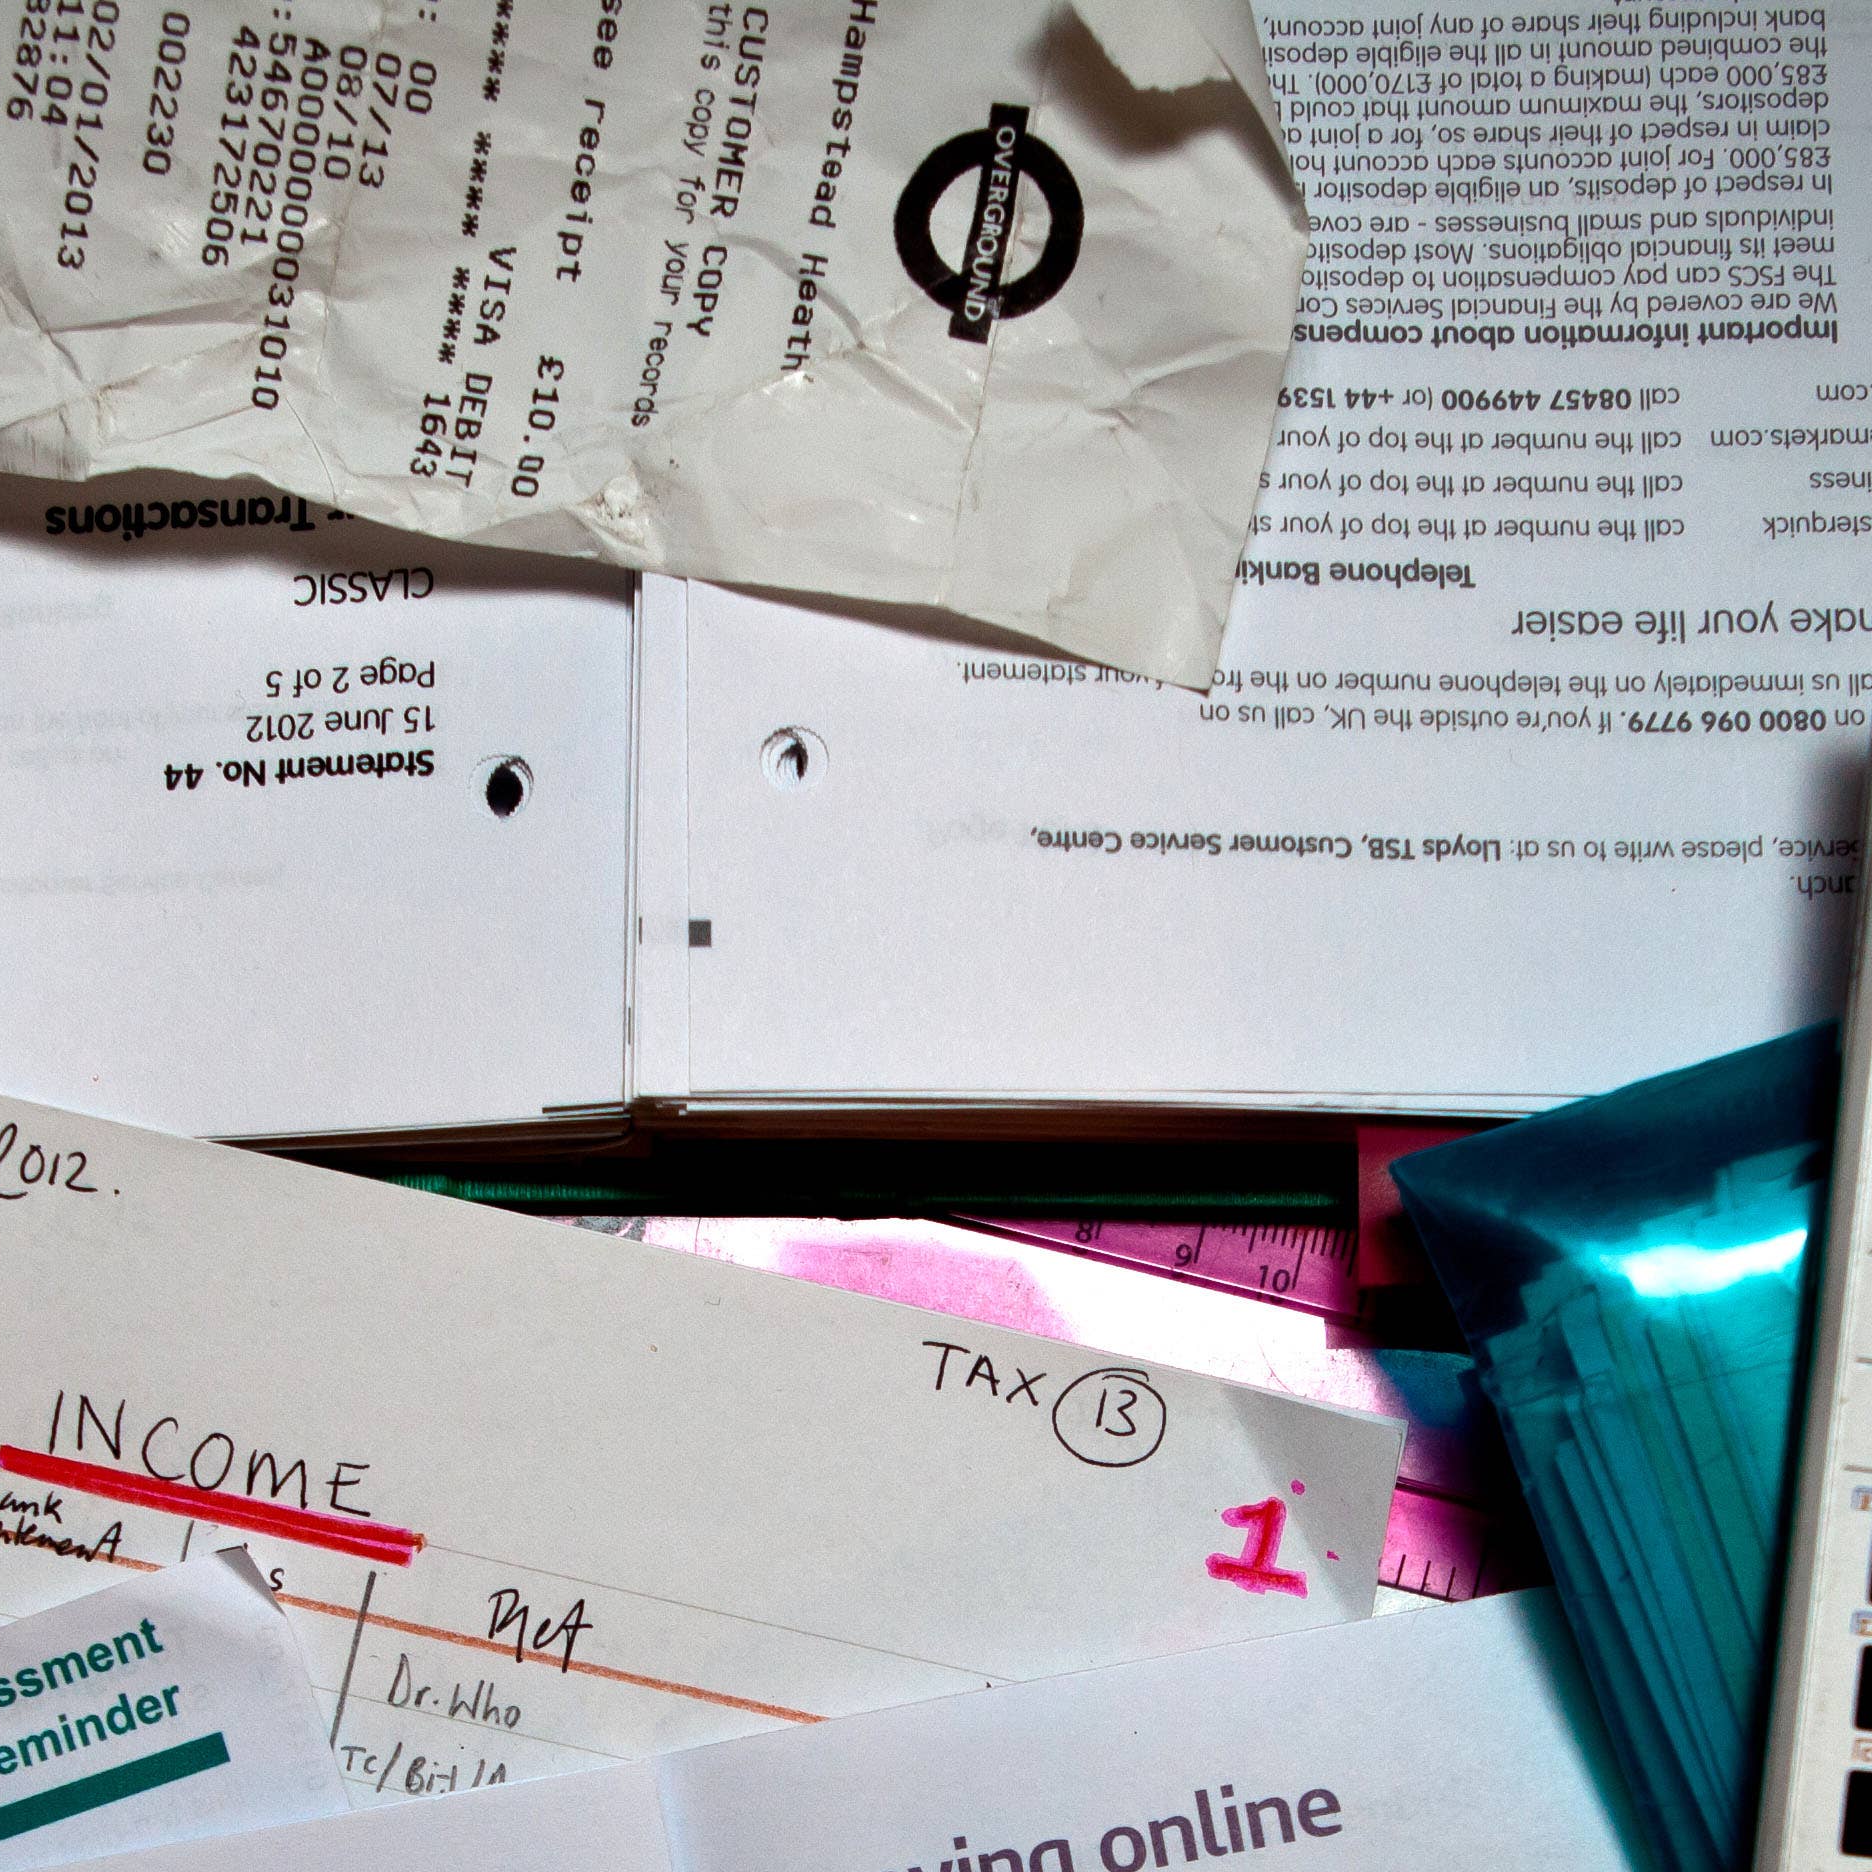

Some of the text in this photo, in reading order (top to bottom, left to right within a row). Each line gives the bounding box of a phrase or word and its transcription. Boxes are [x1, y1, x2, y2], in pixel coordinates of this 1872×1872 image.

[142, 11, 190, 175] 002230
[630, 2, 733, 427] this copy for your records
[686, 6, 768, 336] CUSTOMER COPY
[781, 0, 878, 370] Hampstead Heath
[961, 122, 1019, 324] OVERGROUND
[510, 98, 605, 497] receipt £10.00
[445, 246, 516, 487] VISA DEBIT
[409, 393, 451, 477] 1643
[44, 496, 314, 542] Transactions
[292, 564, 437, 608] CLASSIC
[1510, 600, 1778, 644] your life easier
[246, 705, 434, 742] 15 June 2012
[1620, 710, 1826, 733] 0800 096 9779.
[164, 749, 434, 790] Statement No. 44
[1030, 827, 1500, 862] Lloyds TSB, Customer Service Centre,
[1174, 1242, 1193, 1268] 9
[1259, 1265, 1290, 1293] 10
[922, 1340, 1137, 1436] TAX 13
[40, 1388, 374, 1518] INCOME
[1205, 1497, 1309, 1599] 1
